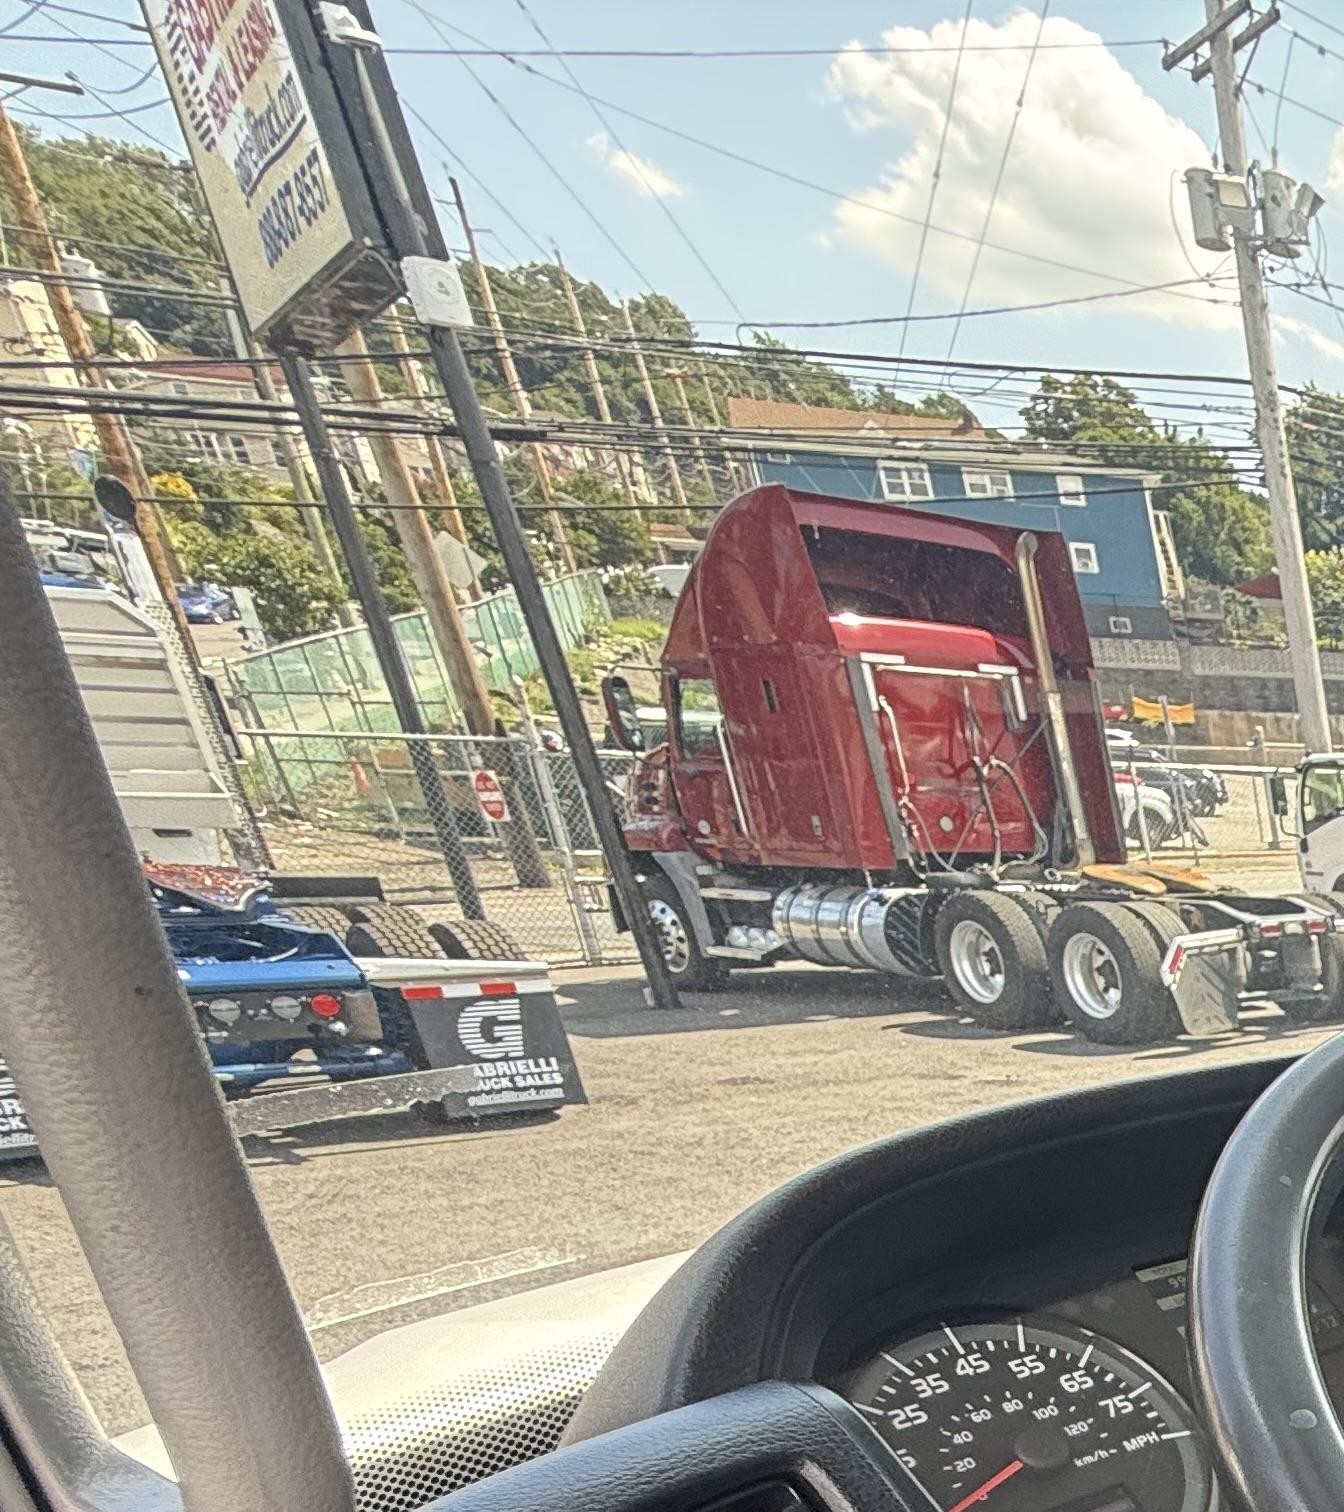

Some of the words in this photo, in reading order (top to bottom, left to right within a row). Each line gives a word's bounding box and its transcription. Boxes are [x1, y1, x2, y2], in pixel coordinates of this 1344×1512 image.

[457, 999, 524, 1058] G
[474, 1057, 559, 1077] ABRIELLI
[479, 1076, 514, 1091] UCK
[514, 1072, 564, 1088] SALES
[955, 1353, 990, 1377] 45
[1008, 1354, 1045, 1379] 55
[910, 1378, 950, 1398] 35
[1060, 1370, 1094, 1393] 65
[970, 1408, 992, 1423] 60
[1002, 1398, 1024, 1414] 80
[1032, 1404, 1059, 1420] 100
[1099, 1394, 1134, 1419] 75
[887, 1403, 928, 1430] 25
[952, 1430, 973, 1444] 40
[1064, 1420, 1089, 1436] 120
[1123, 1431, 1160, 1453] MPH
[953, 1457, 976, 1473] 20
[1074, 1449, 1109, 1468] km/h
